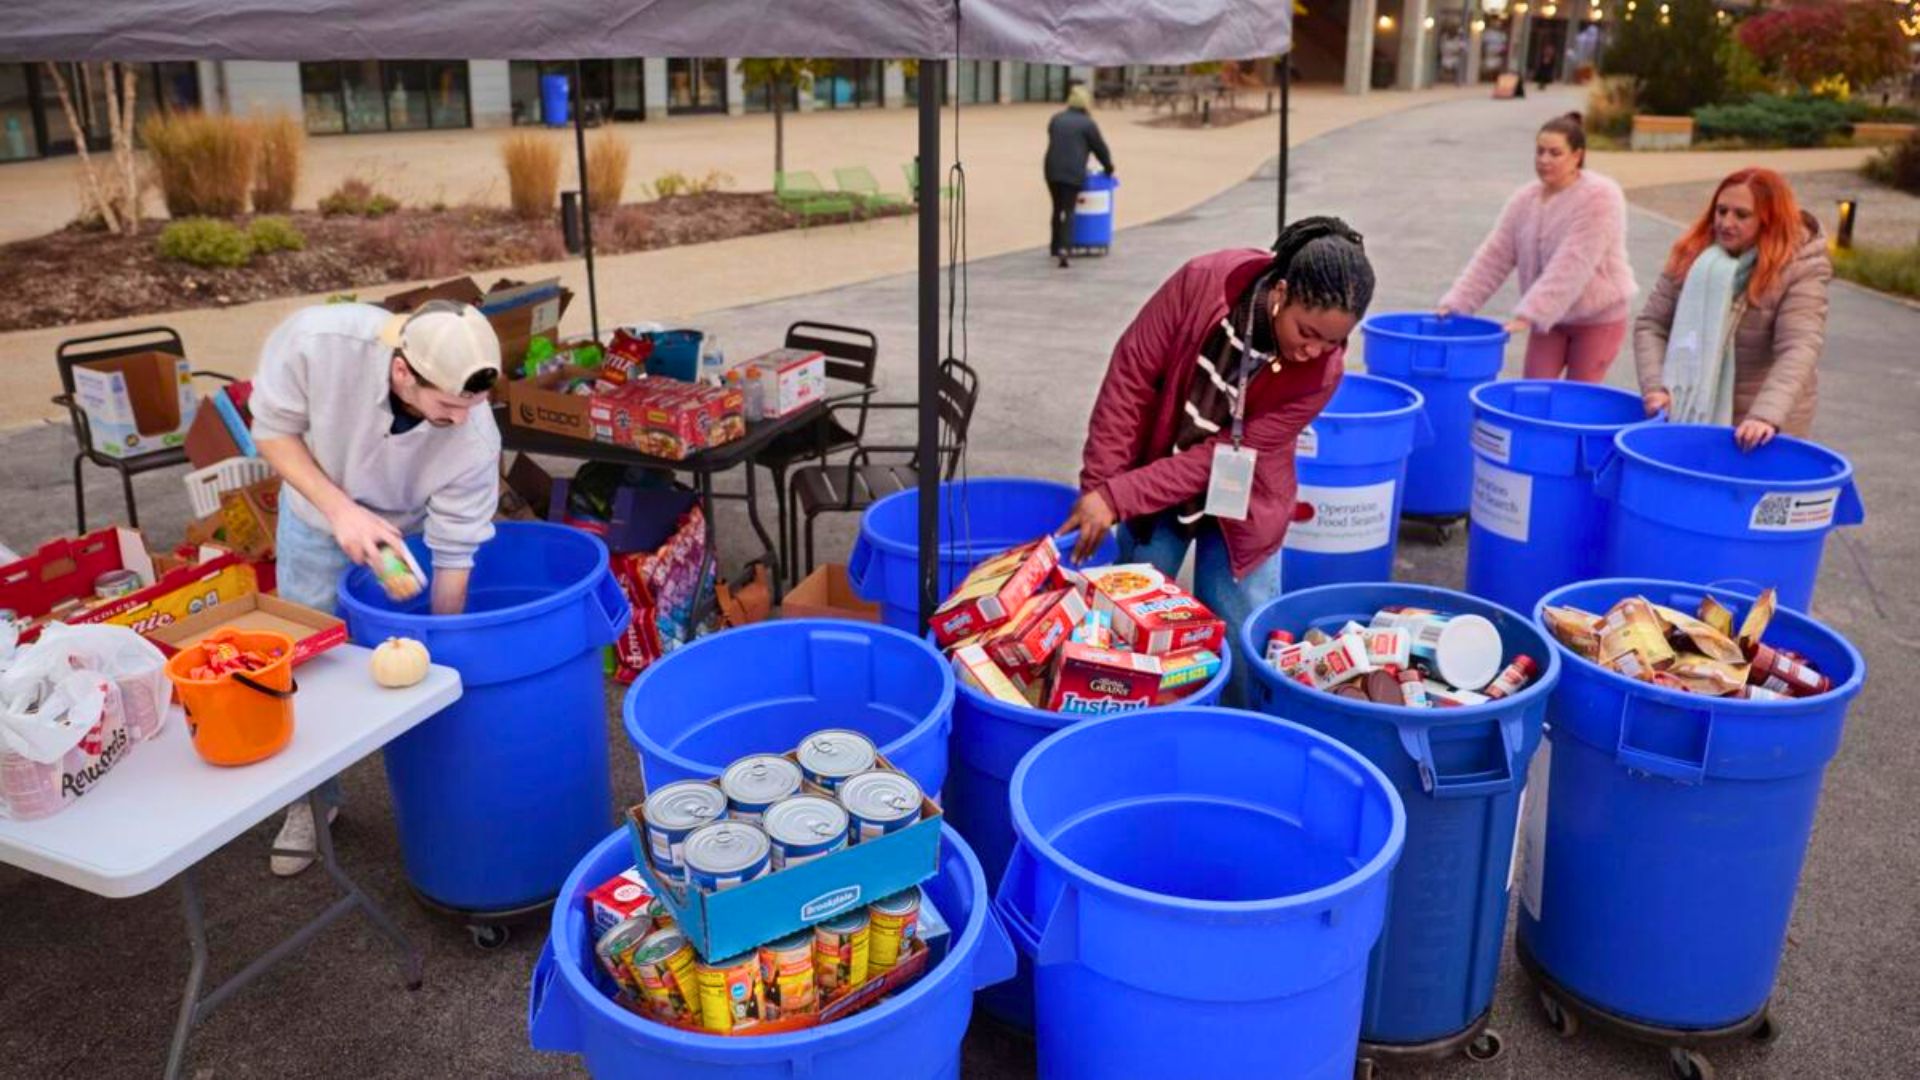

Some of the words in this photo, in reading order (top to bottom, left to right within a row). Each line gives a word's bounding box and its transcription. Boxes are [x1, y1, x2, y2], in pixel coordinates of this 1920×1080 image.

[1318, 501, 1378, 517] Operation
[1317, 515, 1348, 528] Food
[1351, 511, 1386, 527] Search
[61, 727, 127, 799] Rewards
